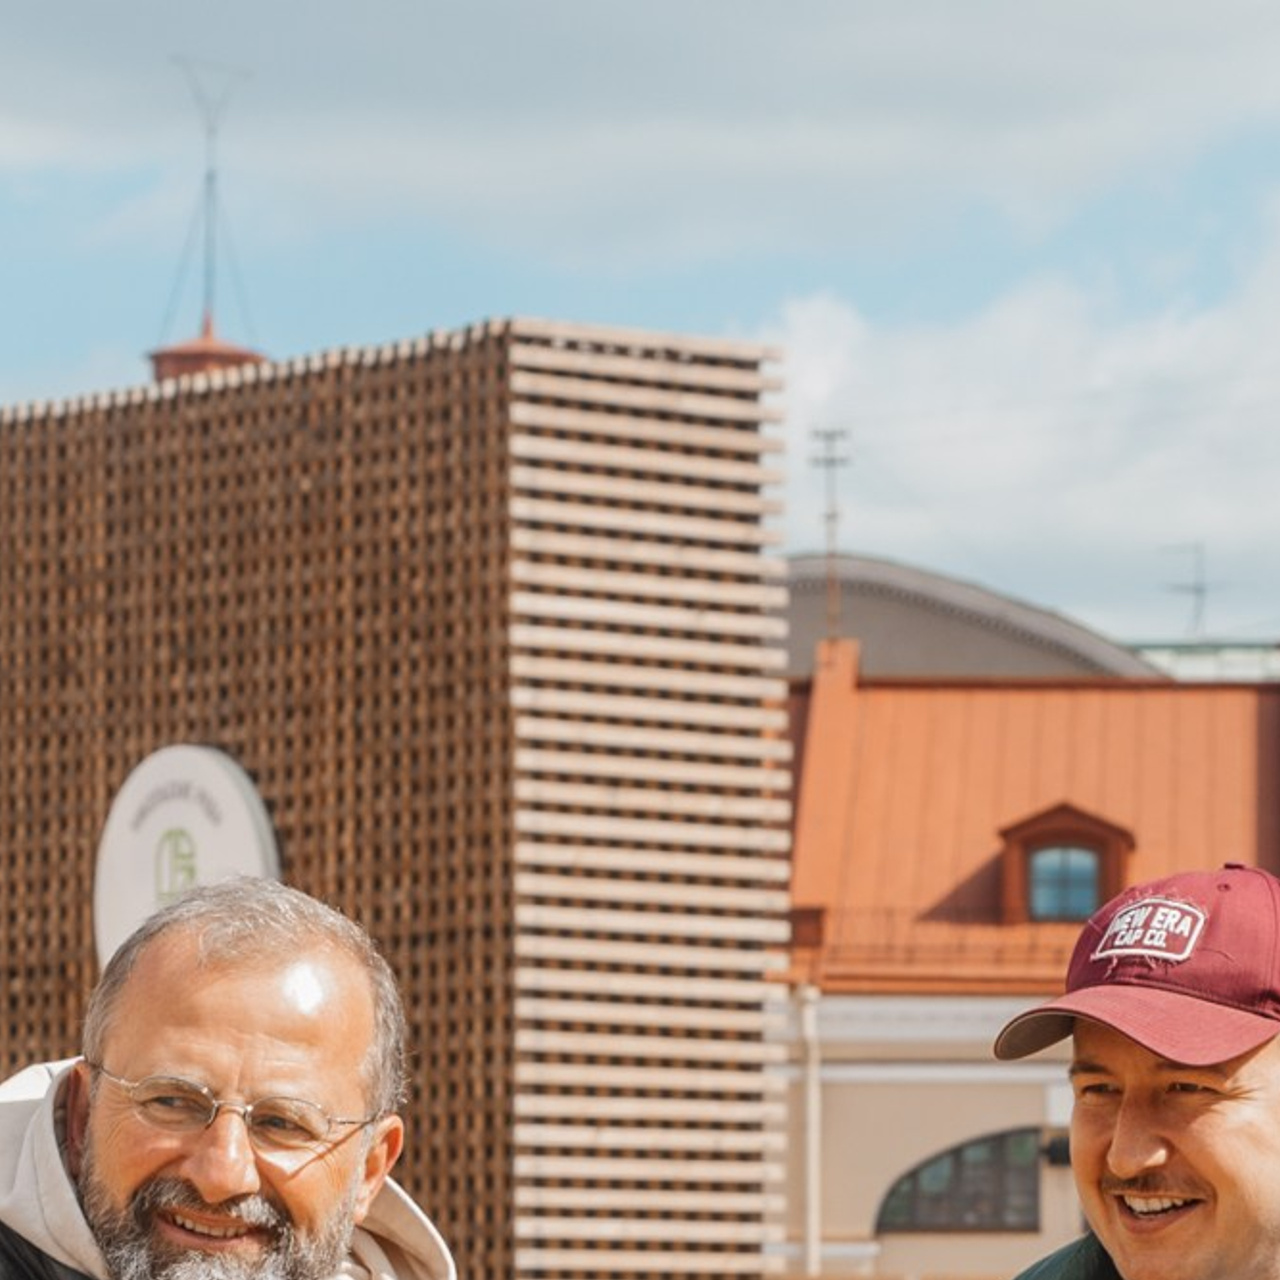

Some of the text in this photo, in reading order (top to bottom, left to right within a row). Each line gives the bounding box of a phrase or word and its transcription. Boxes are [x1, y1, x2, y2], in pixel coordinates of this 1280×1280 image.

[1109, 905, 1192, 937] NEW ERA
[1114, 929, 1167, 947] CAP CO.
